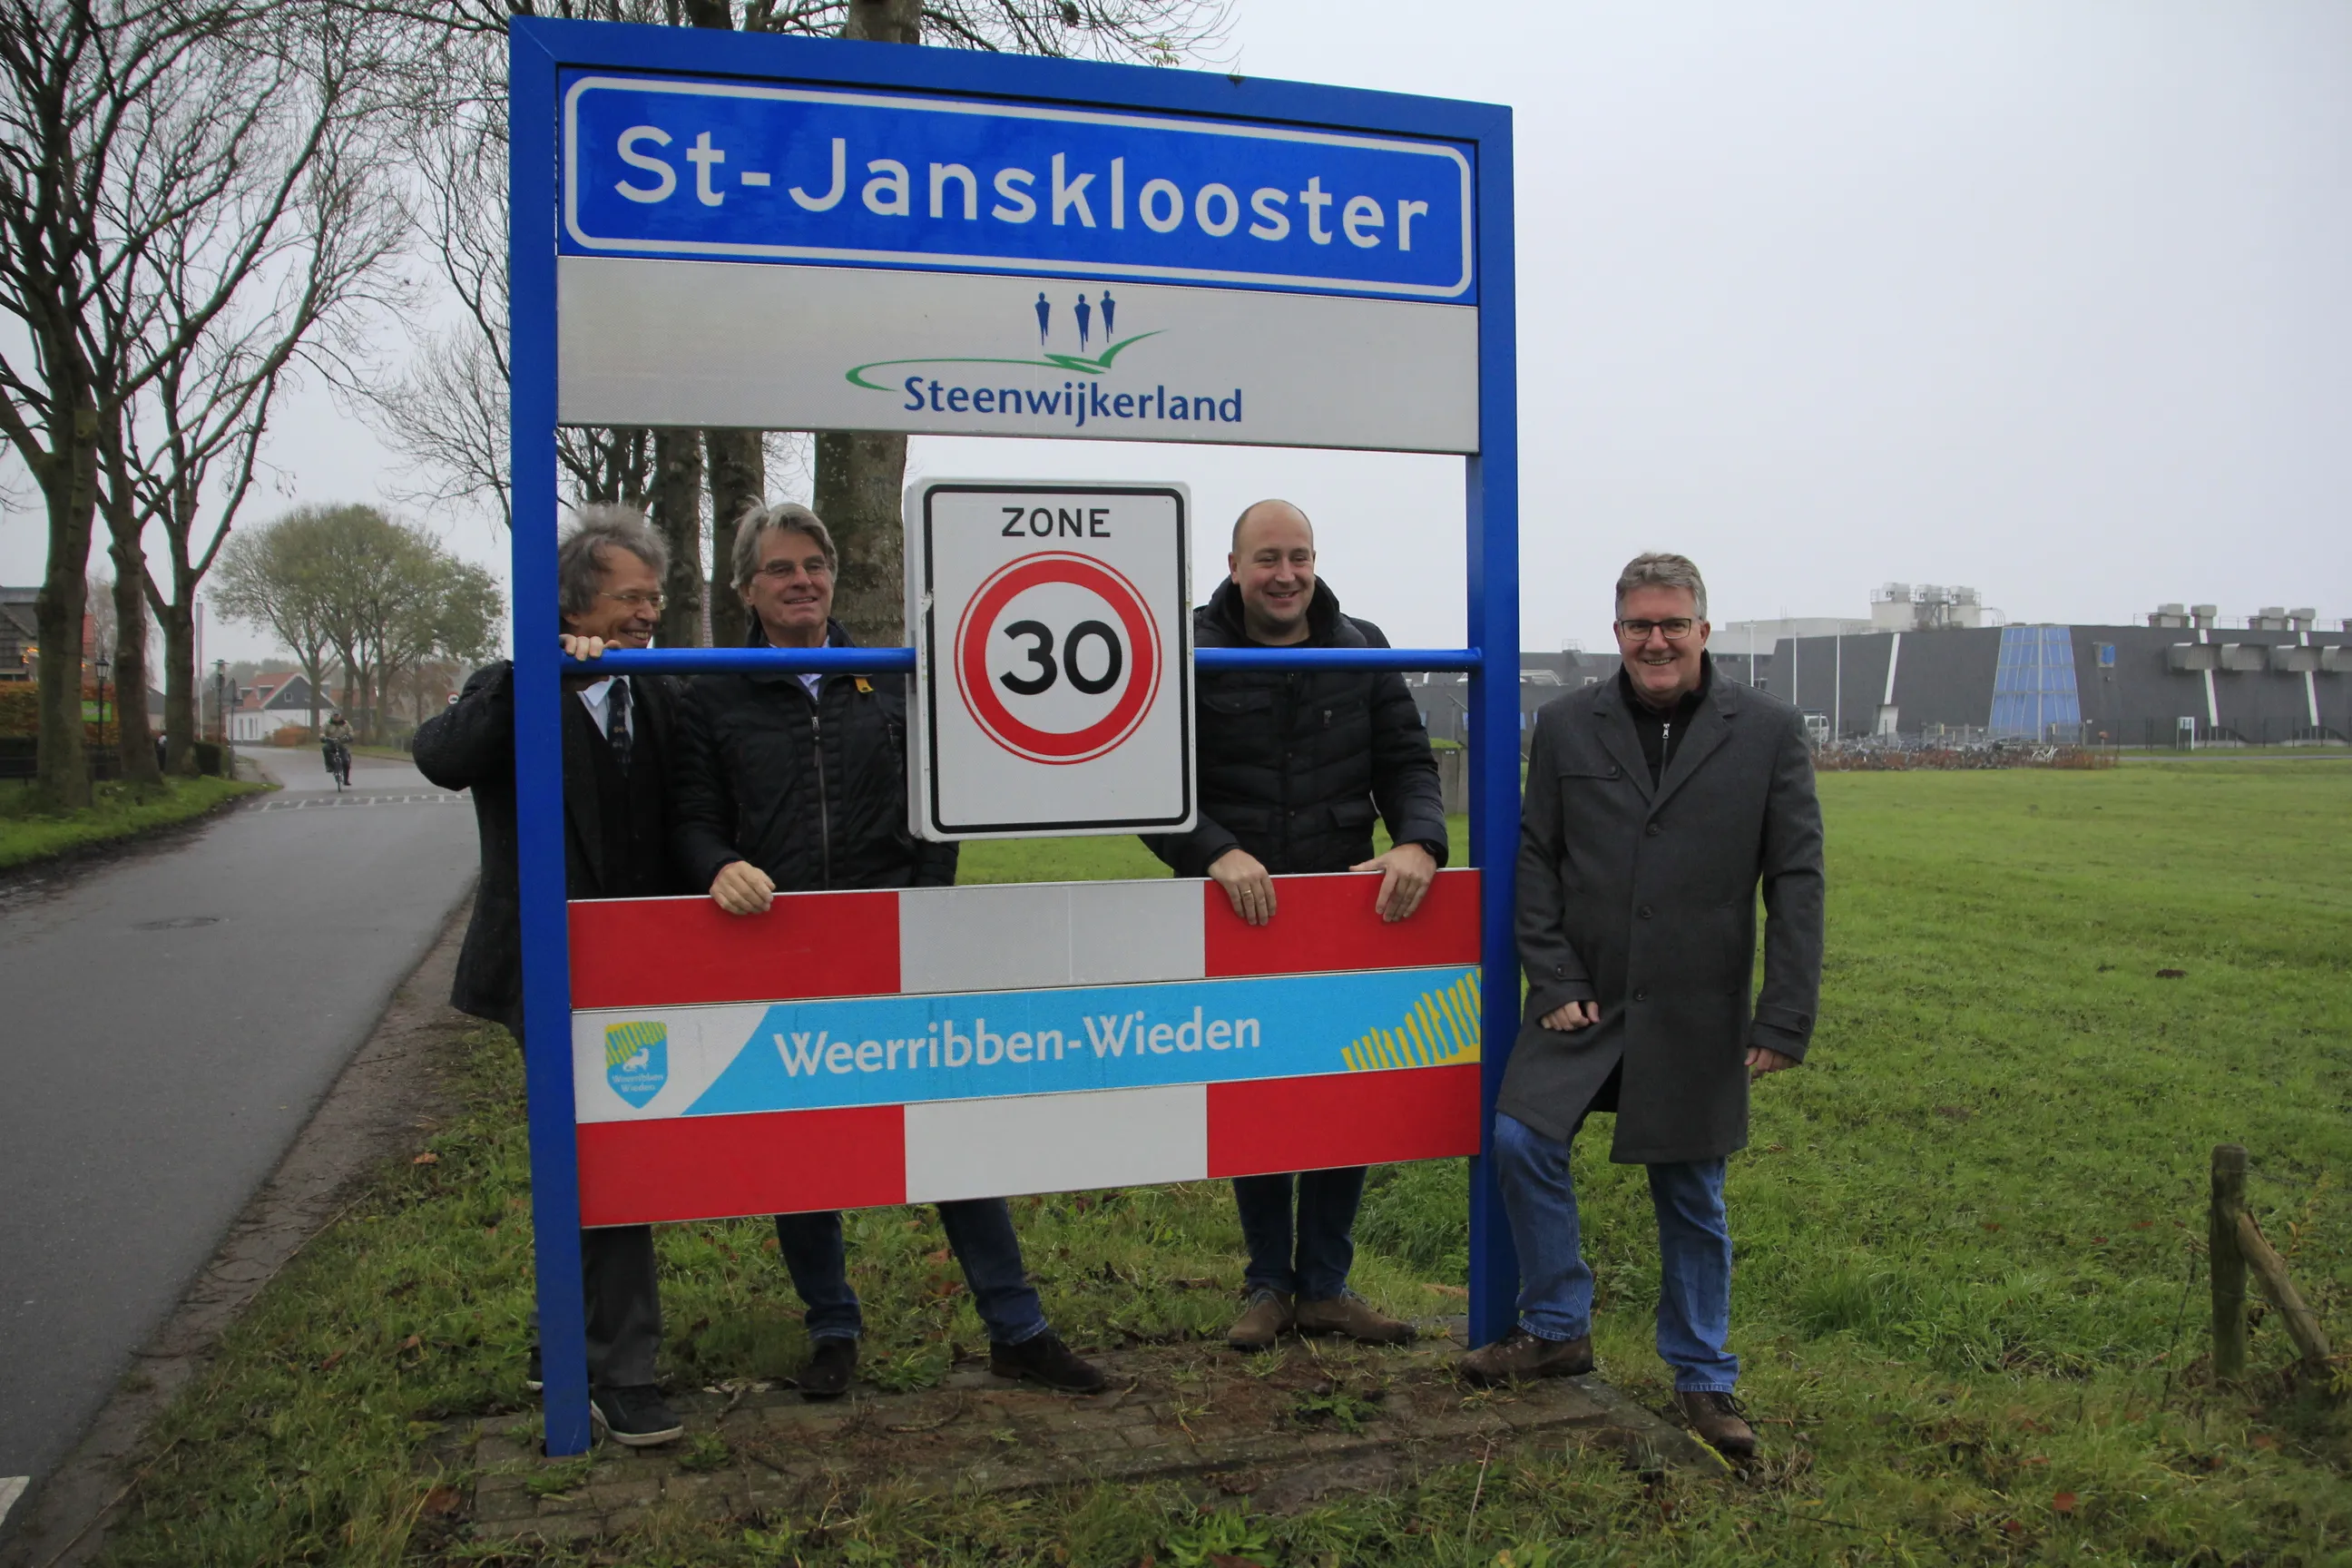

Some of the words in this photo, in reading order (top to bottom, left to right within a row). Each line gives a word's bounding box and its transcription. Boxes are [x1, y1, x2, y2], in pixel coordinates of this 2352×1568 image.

[613, 123, 1429, 250] St-Jansklooster
[903, 375, 1244, 426] Steenwijkerland
[1002, 507, 1111, 537] ZONE
[999, 620, 1122, 695] 30
[773, 1007, 1261, 1077] Weerribben-Wieden
